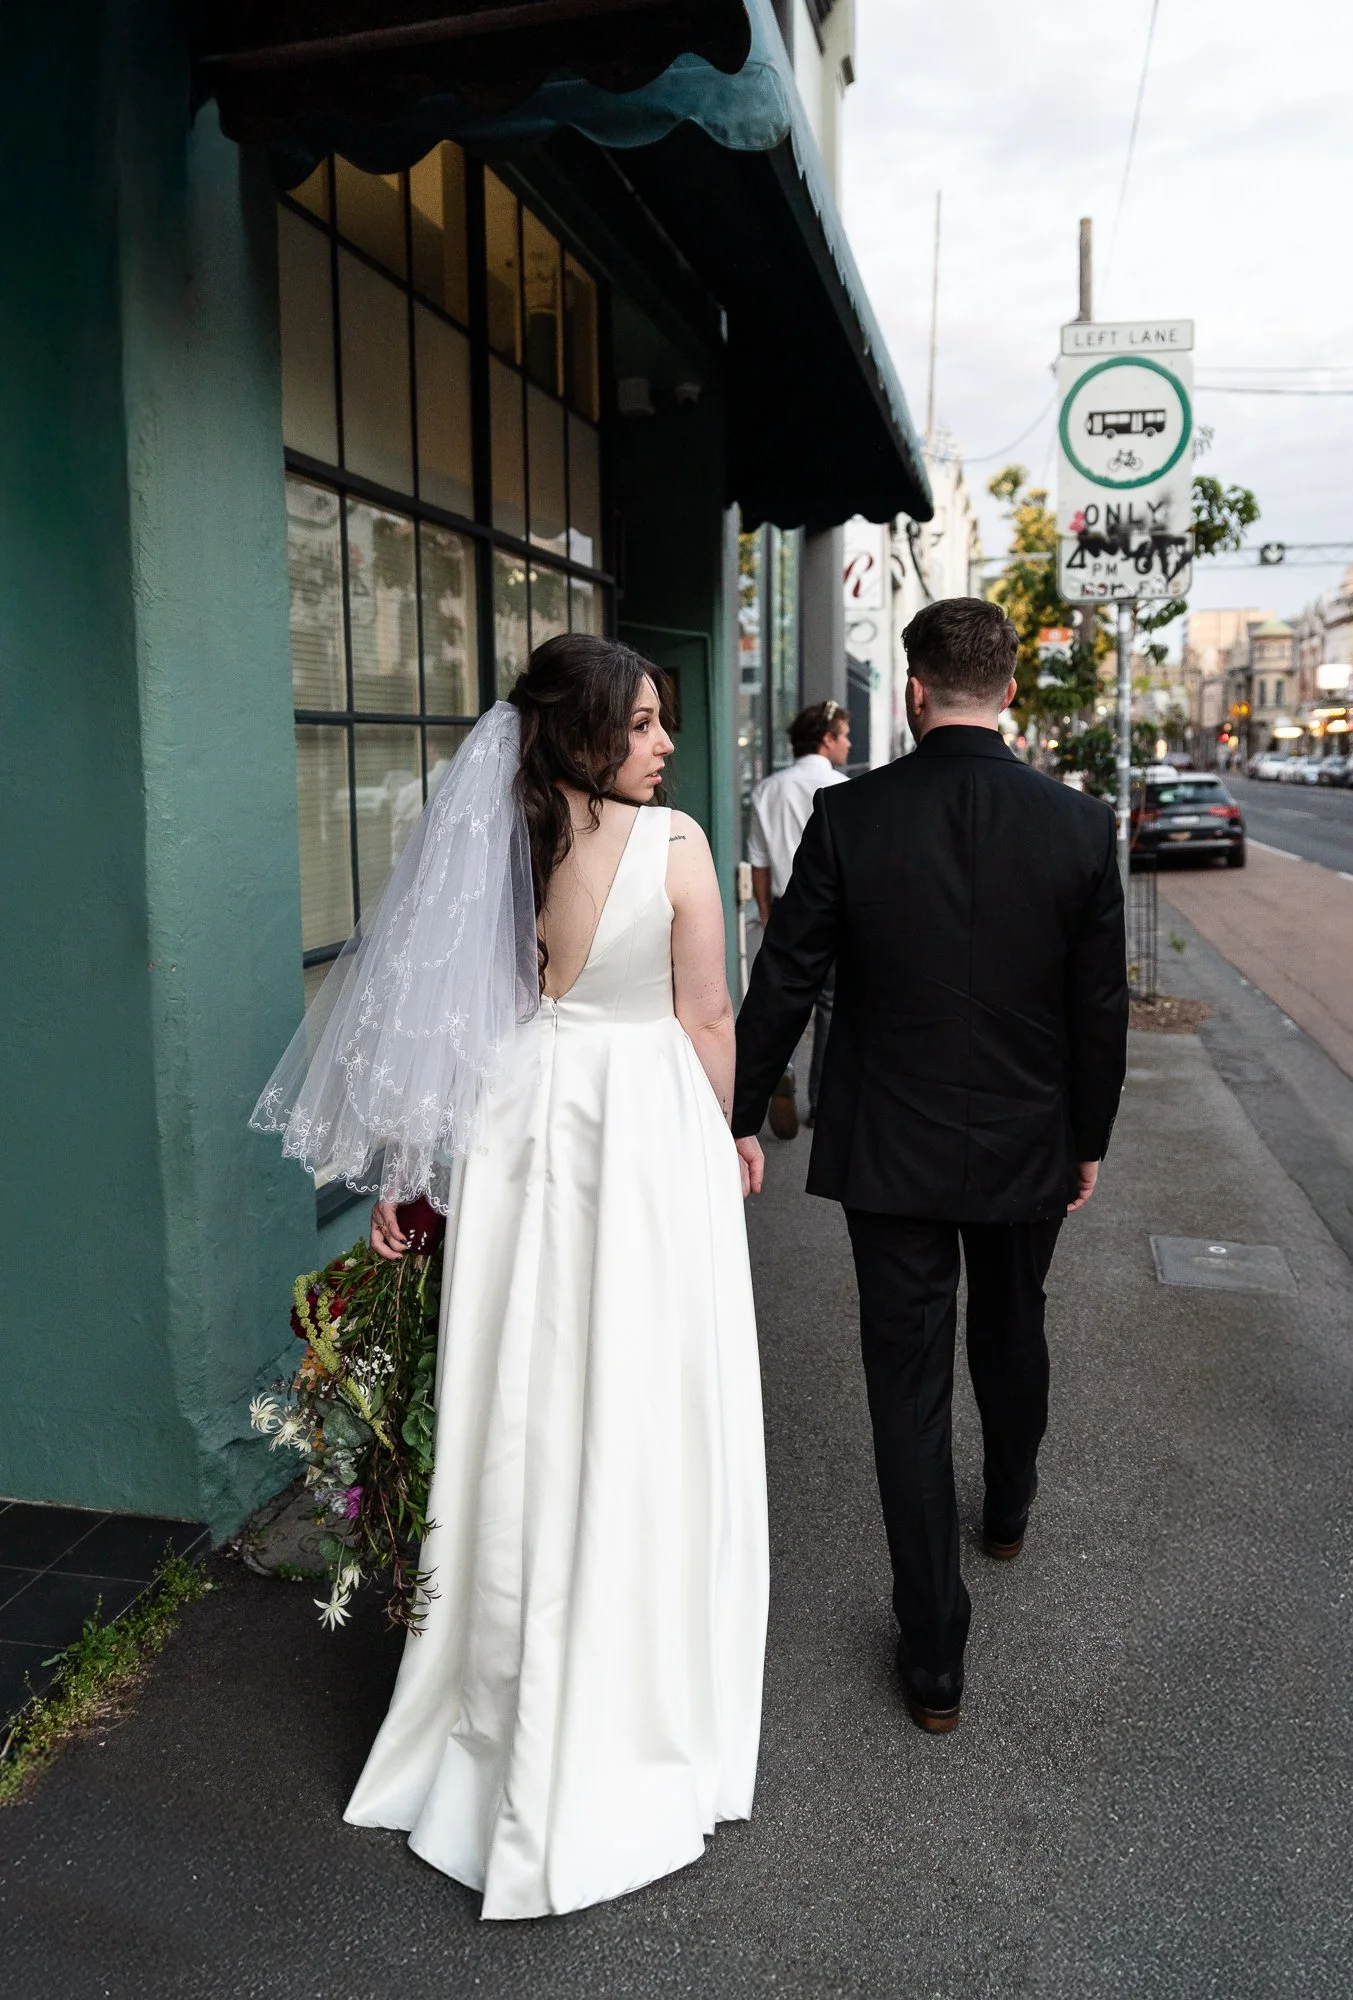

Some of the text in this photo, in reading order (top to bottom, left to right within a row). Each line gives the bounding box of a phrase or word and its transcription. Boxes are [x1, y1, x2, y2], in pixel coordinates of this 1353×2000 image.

[1073, 328, 1178, 348] LEFT LANE
[1085, 502, 1164, 526] ONLY
